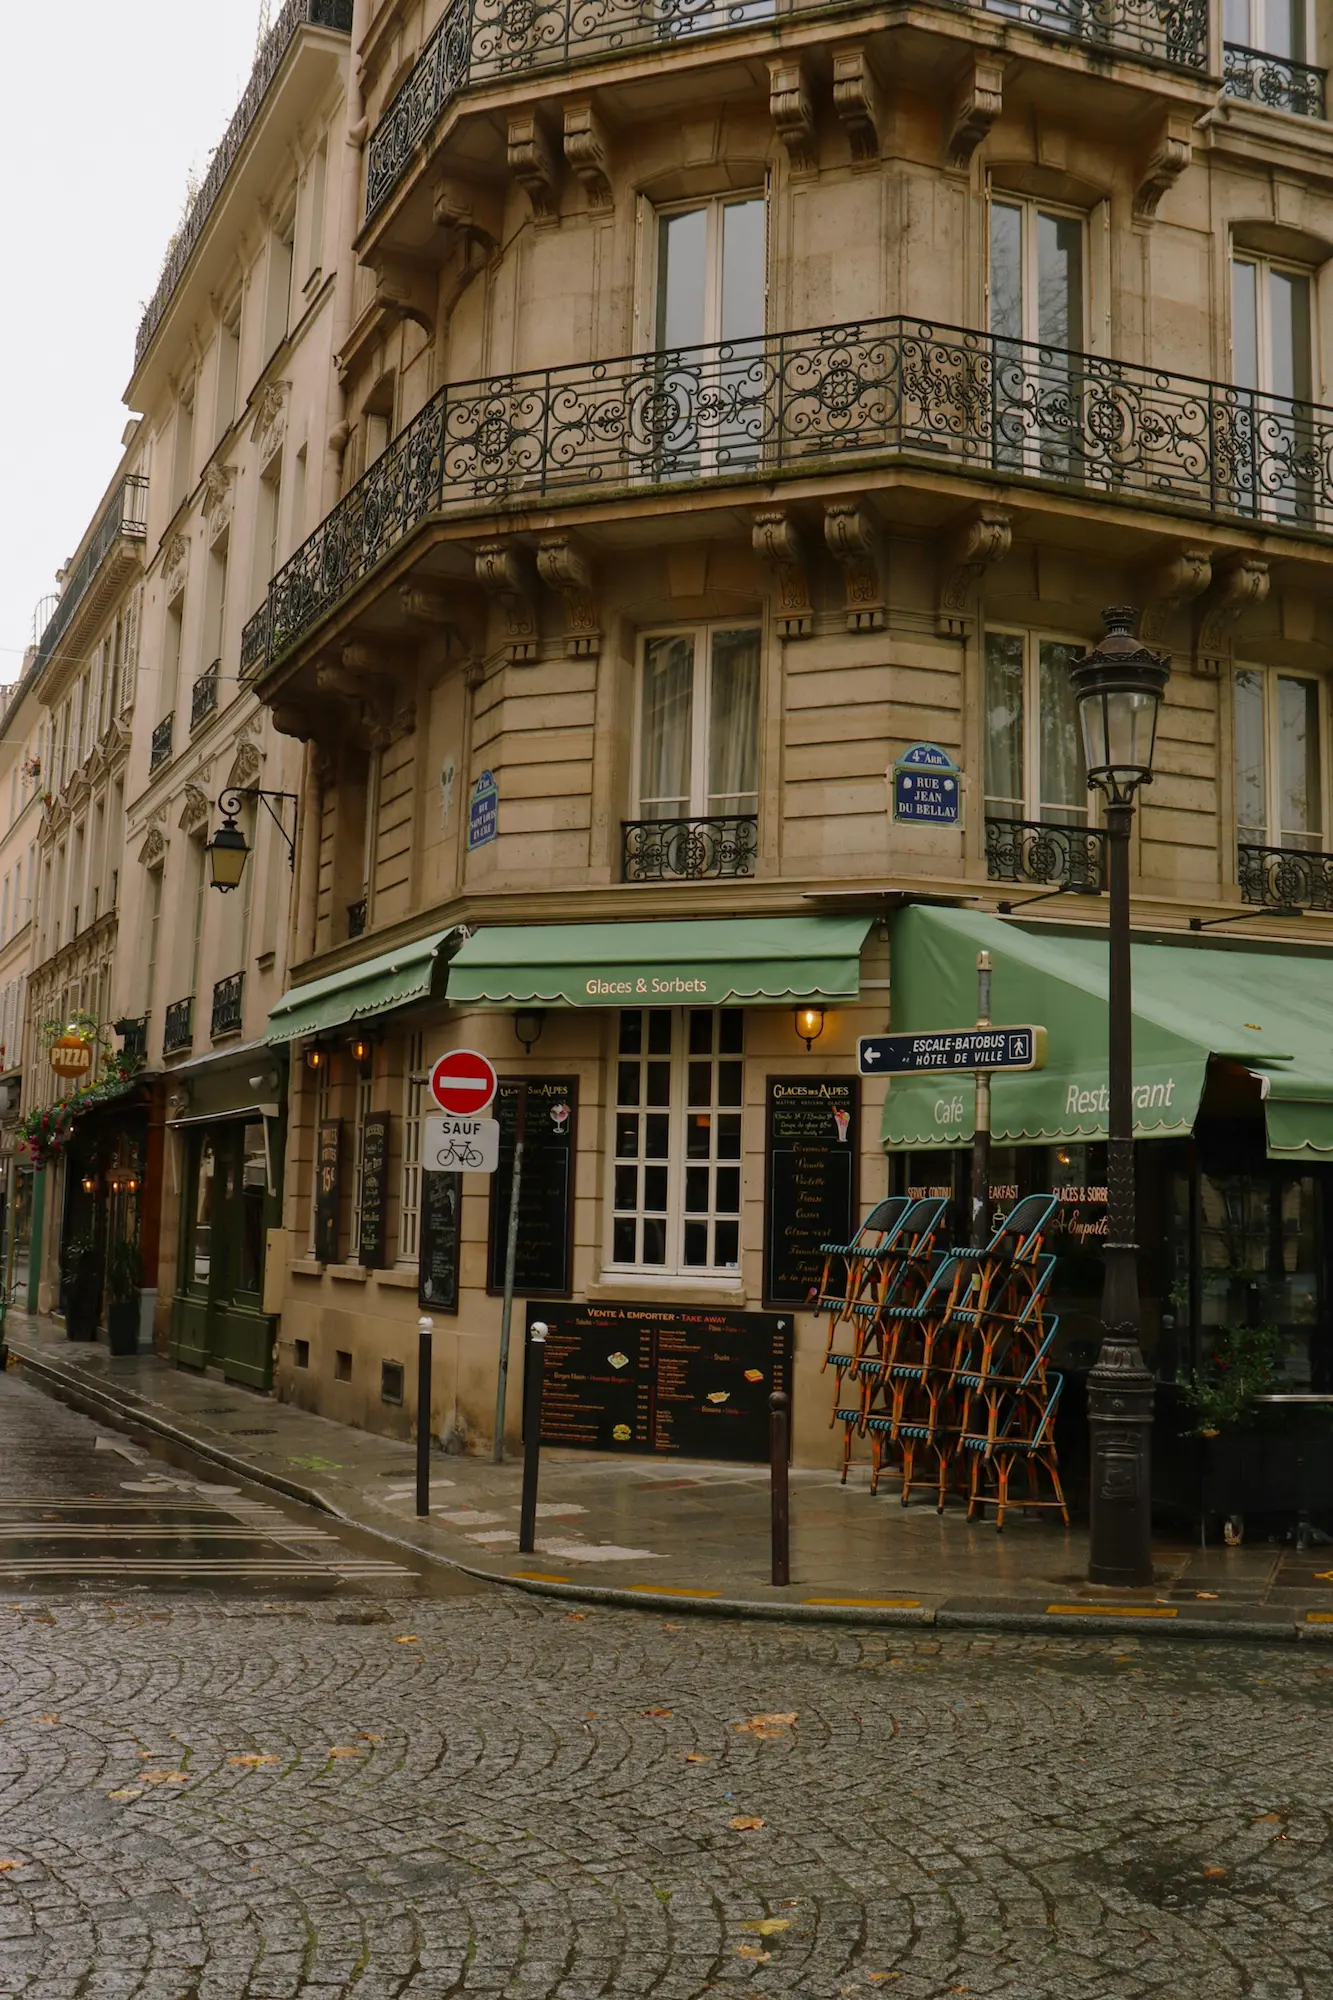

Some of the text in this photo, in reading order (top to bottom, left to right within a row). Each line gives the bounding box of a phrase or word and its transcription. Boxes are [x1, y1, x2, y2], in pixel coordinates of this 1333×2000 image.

[916, 777, 939, 789] RUE
[914, 791, 942, 802] JEAN
[899, 802, 956, 817] DU BELLAY
[586, 977, 707, 994] Glaces & Sorbets
[913, 1035, 1006, 1052] ESCALE-BATOBUS
[51, 1048, 89, 1066] PIZZA
[916, 1051, 1003, 1065] HÔTEL DE VILLE
[541, 1084, 569, 1098] ALPES
[773, 1084, 808, 1098] GLACES
[818, 1084, 849, 1099] ALPES
[934, 1095, 964, 1124] Café
[442, 1122, 482, 1135] SAUF
[988, 1184, 1020, 1200] EAKFAST
[1079, 1187, 1087, 1202] &
[1068, 1208, 1109, 1245] Emporte
[587, 1308, 617, 1318] VENTE
[618, 1309, 625, 1319] À
[627, 1312, 675, 1321] EMPORTER
[681, 1313, 703, 1323] TAKE
[704, 1315, 727, 1324] AWAY
